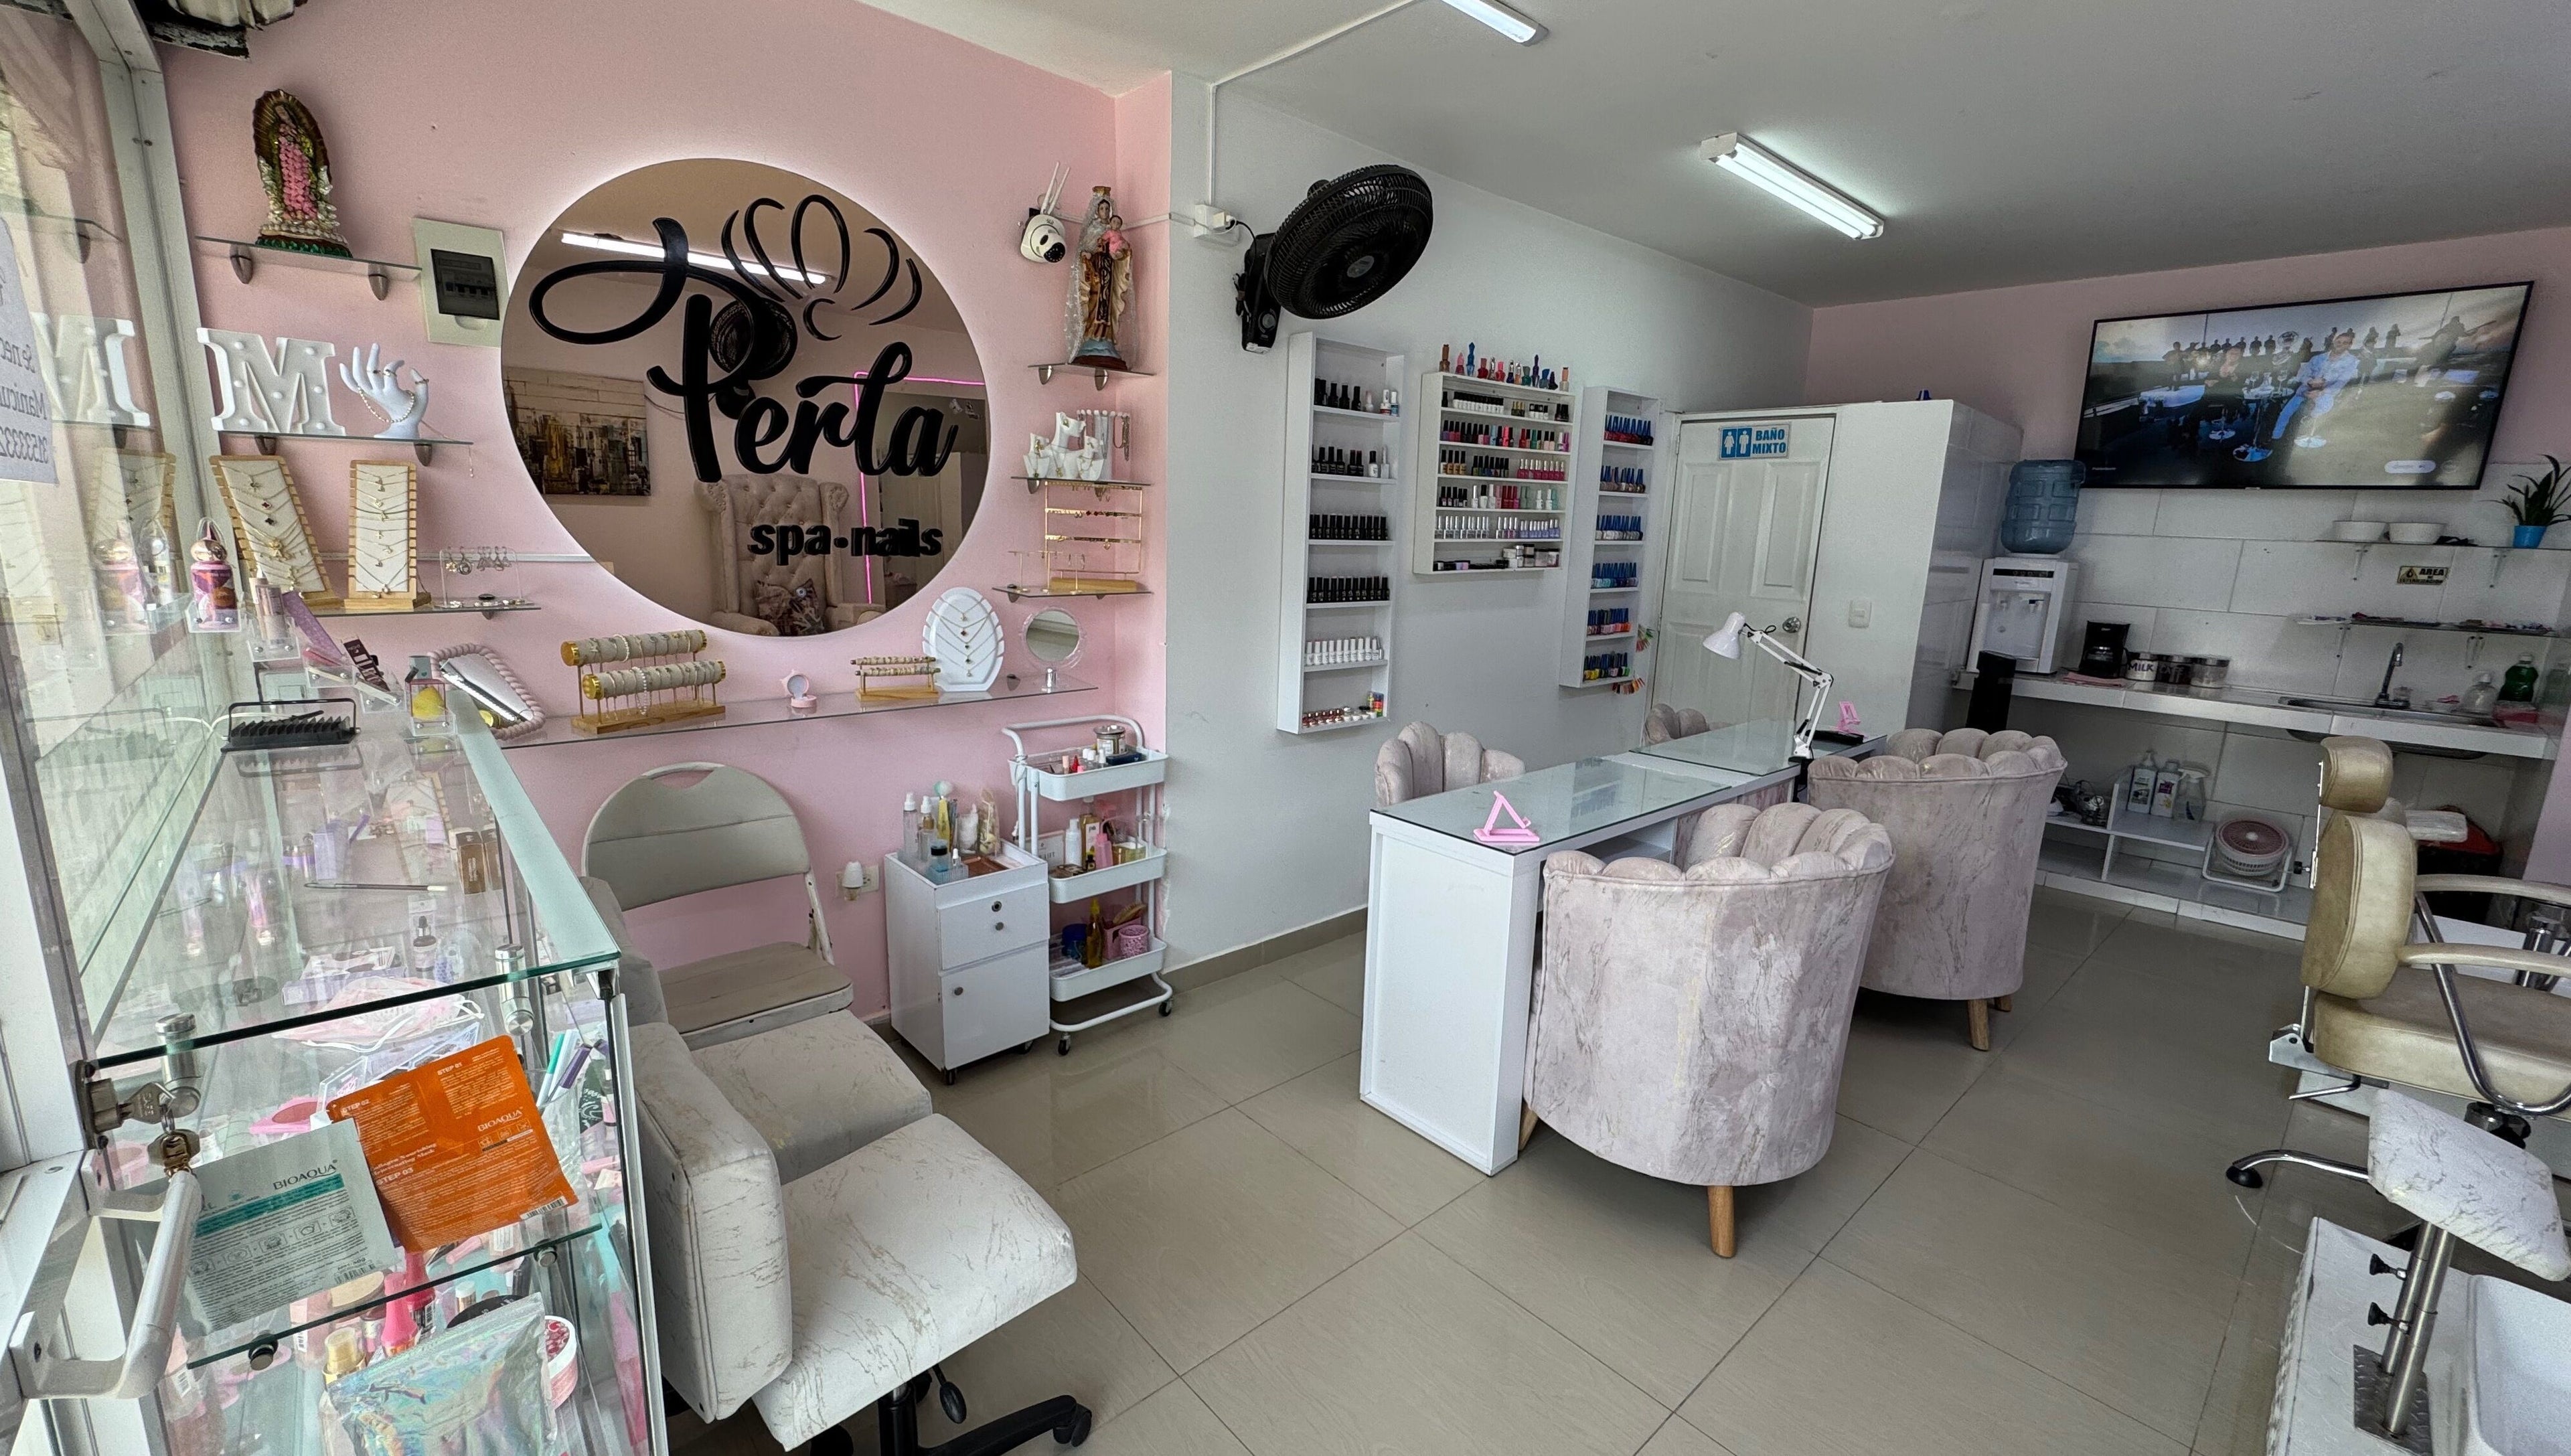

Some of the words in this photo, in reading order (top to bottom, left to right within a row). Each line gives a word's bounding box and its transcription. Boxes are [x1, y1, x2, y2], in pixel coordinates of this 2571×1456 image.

[529, 218, 959, 483] Perla
[197, 327, 346, 436] M
[1755, 428, 1785, 441] BAÑO
[1752, 442, 1786, 454] MIXTO
[2130, 663, 2154, 671] MILK
[437, 1066, 454, 1076] STEP
[341, 1102, 361, 1115] STEP
[477, 1109, 523, 1132] BIOAQUA
[273, 1164, 337, 1190] BIOAQUA
[376, 1172, 400, 1185] STEP
[402, 1167, 414, 1176] 03
